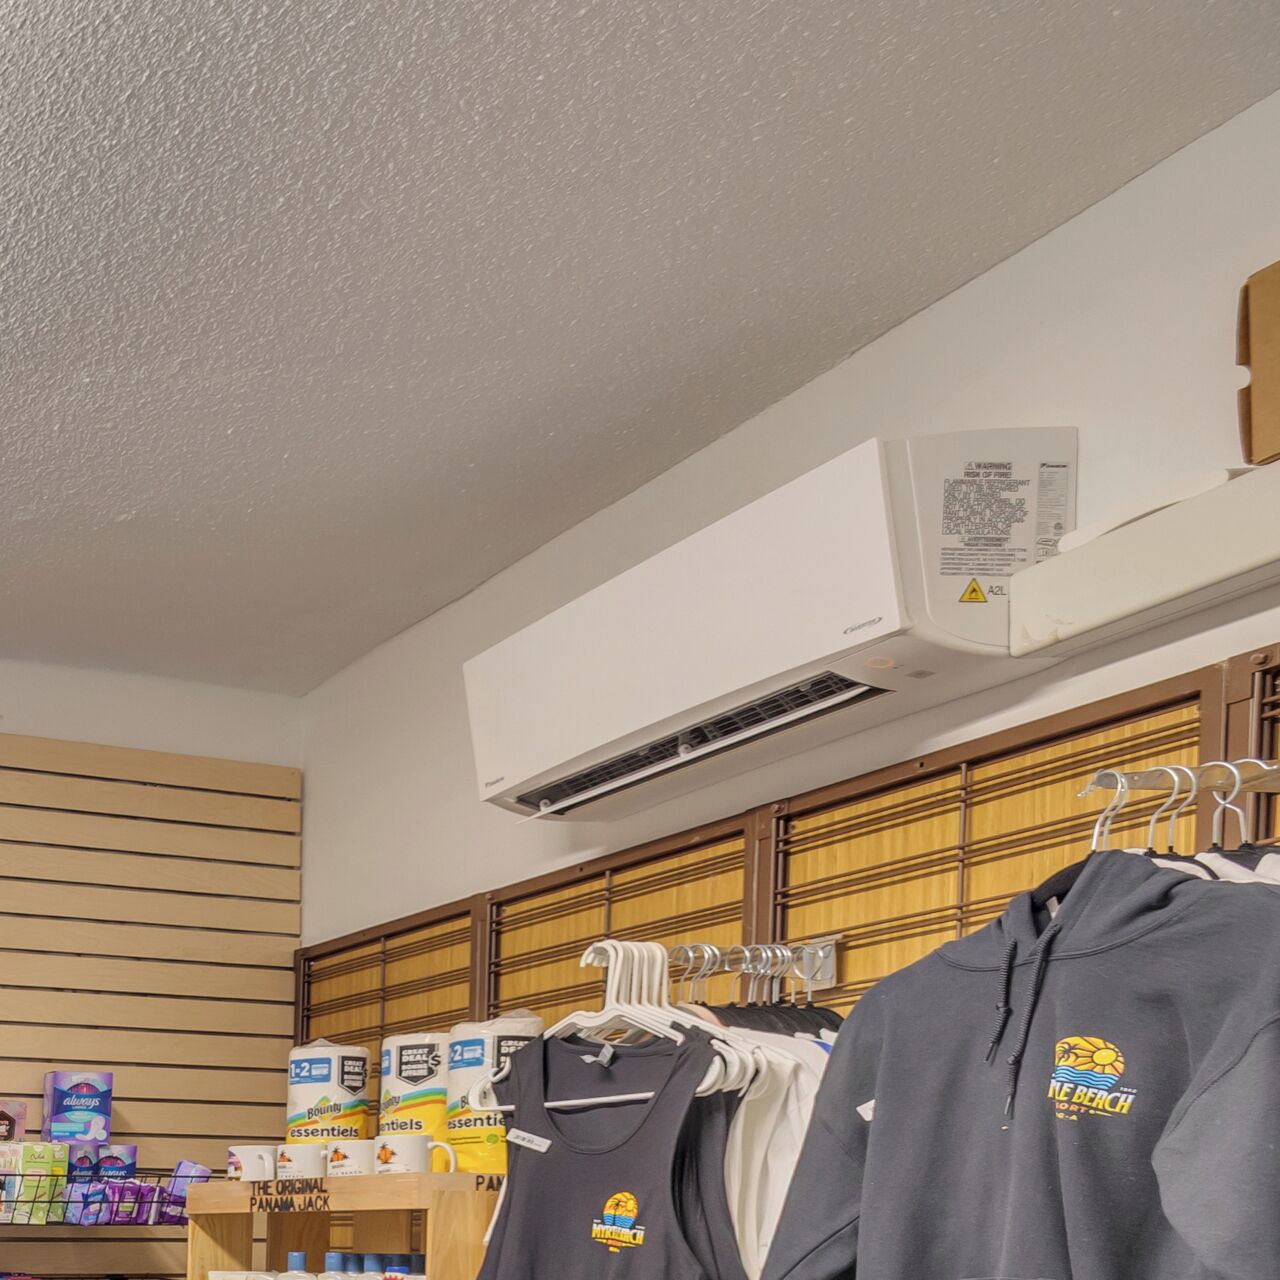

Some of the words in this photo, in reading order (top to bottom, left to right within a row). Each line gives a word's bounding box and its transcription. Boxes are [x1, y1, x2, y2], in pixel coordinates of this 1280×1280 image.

[401, 1048, 429, 1057] GREAT
[63, 1095, 101, 1109] always
[1072, 1084, 1137, 1115] BEACH
[307, 1103, 342, 1120] Bounty
[290, 1125, 360, 1138] essentiels
[380, 1118, 423, 1132] entiels
[99, 1168, 127, 1177] lways
[251, 1180, 274, 1195] THE
[276, 1178, 328, 1195] ORIGINAL
[250, 1197, 296, 1212] PANAMA
[298, 1195, 331, 1212] JACK
